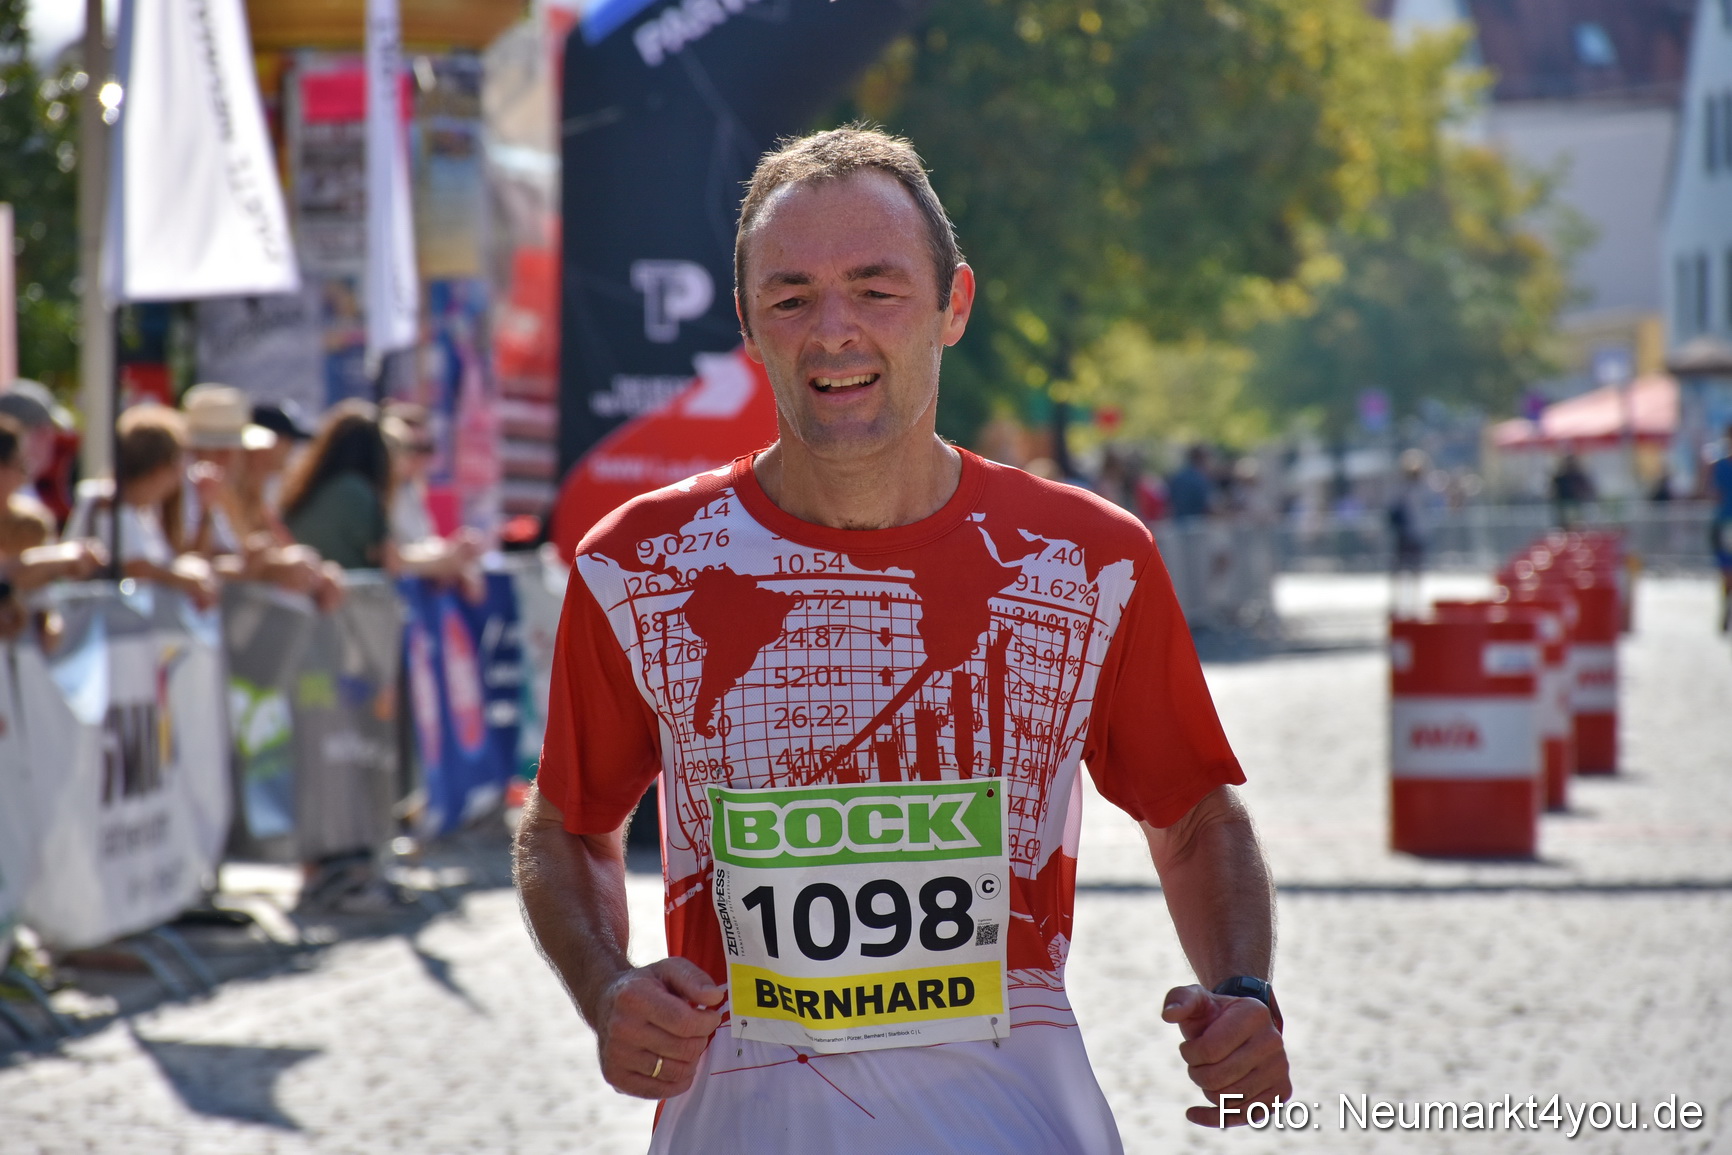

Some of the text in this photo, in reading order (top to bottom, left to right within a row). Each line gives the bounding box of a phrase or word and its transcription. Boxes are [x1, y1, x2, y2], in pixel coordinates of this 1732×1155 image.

[773, 552, 845, 574] 10.54
[1015, 572, 1097, 606] 91.62%
[774, 627, 846, 649] 24.87
[774, 666, 847, 688] 52.01
[773, 704, 849, 730] 26.22
[723, 792, 982, 859] BOCK
[981, 879, 995, 894] C
[742, 876, 975, 961] 1098
[755, 976, 975, 1020] BERNHARD
